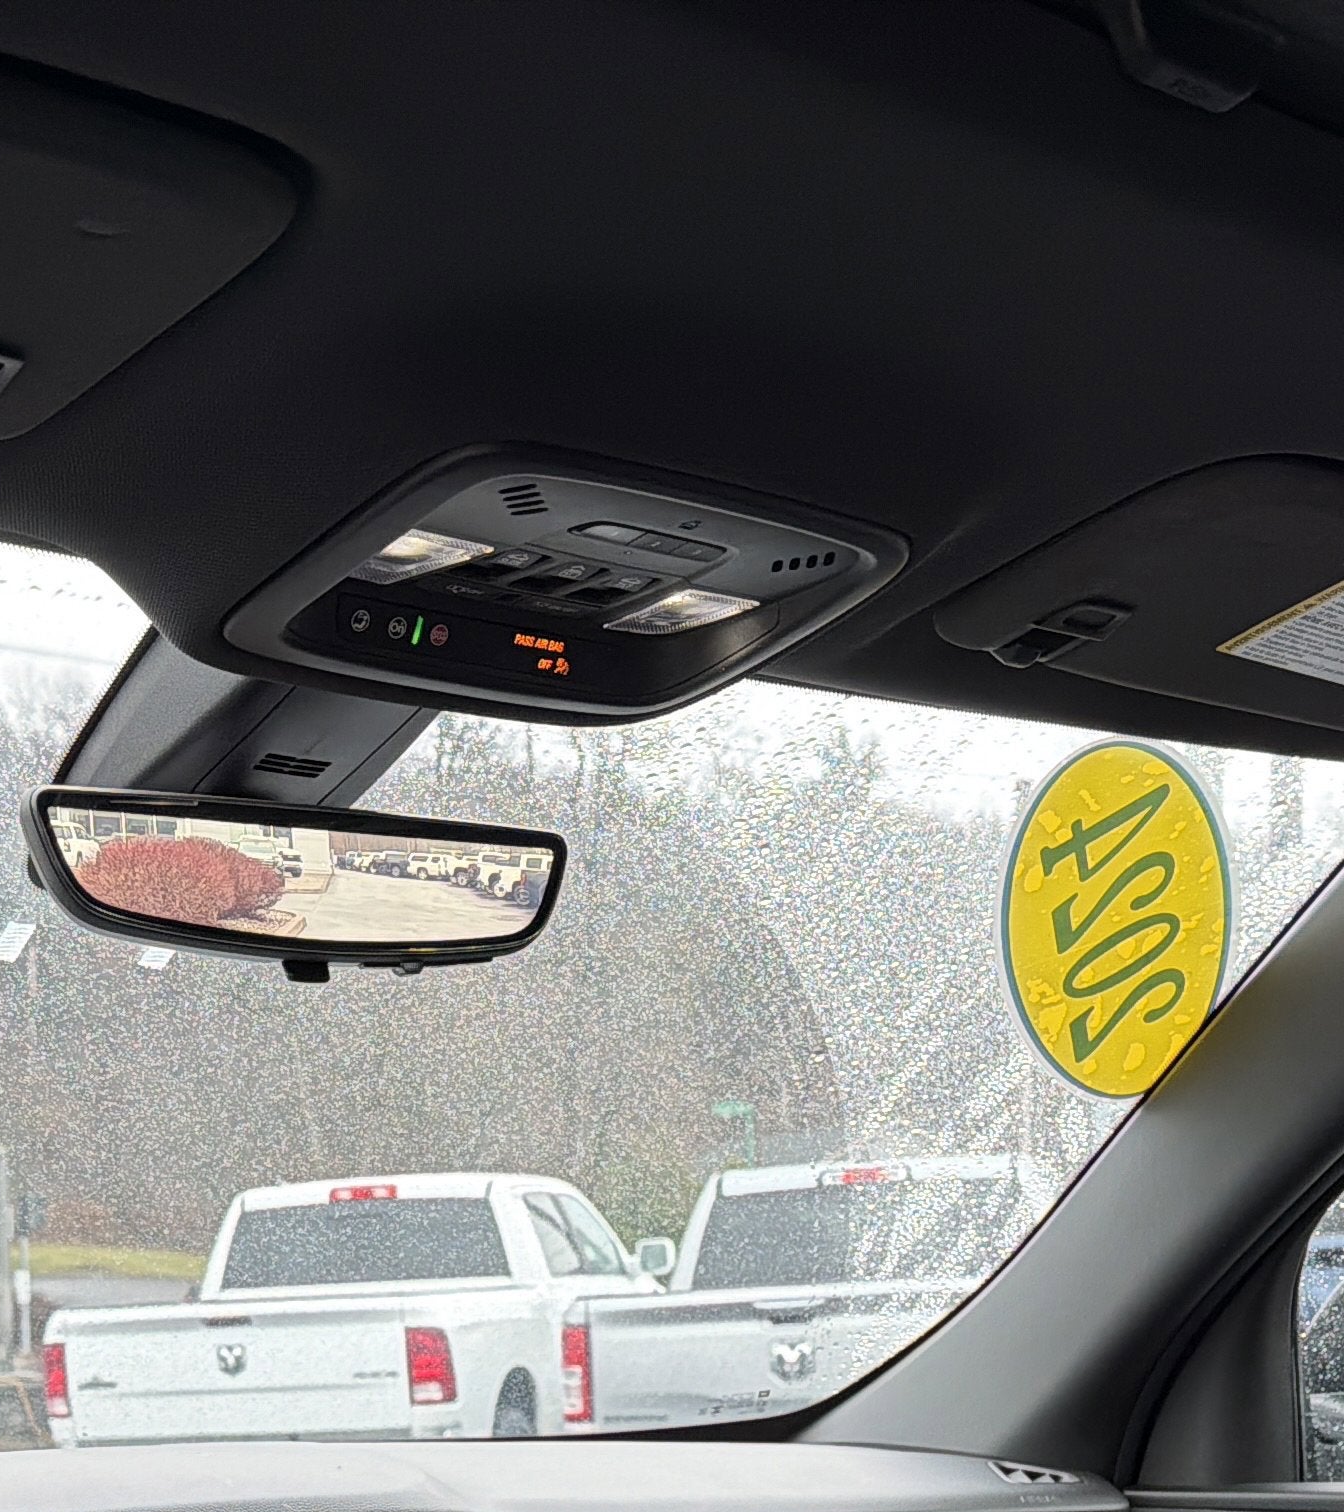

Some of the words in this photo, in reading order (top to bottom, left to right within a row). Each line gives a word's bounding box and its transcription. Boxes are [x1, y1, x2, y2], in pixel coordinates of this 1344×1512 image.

[513, 633, 536, 649] PASS
[535, 637, 548, 651] AIR
[548, 640, 565, 654] BAG
[537, 658, 553, 671] OFF
[1039, 783, 1186, 1064] 2024
